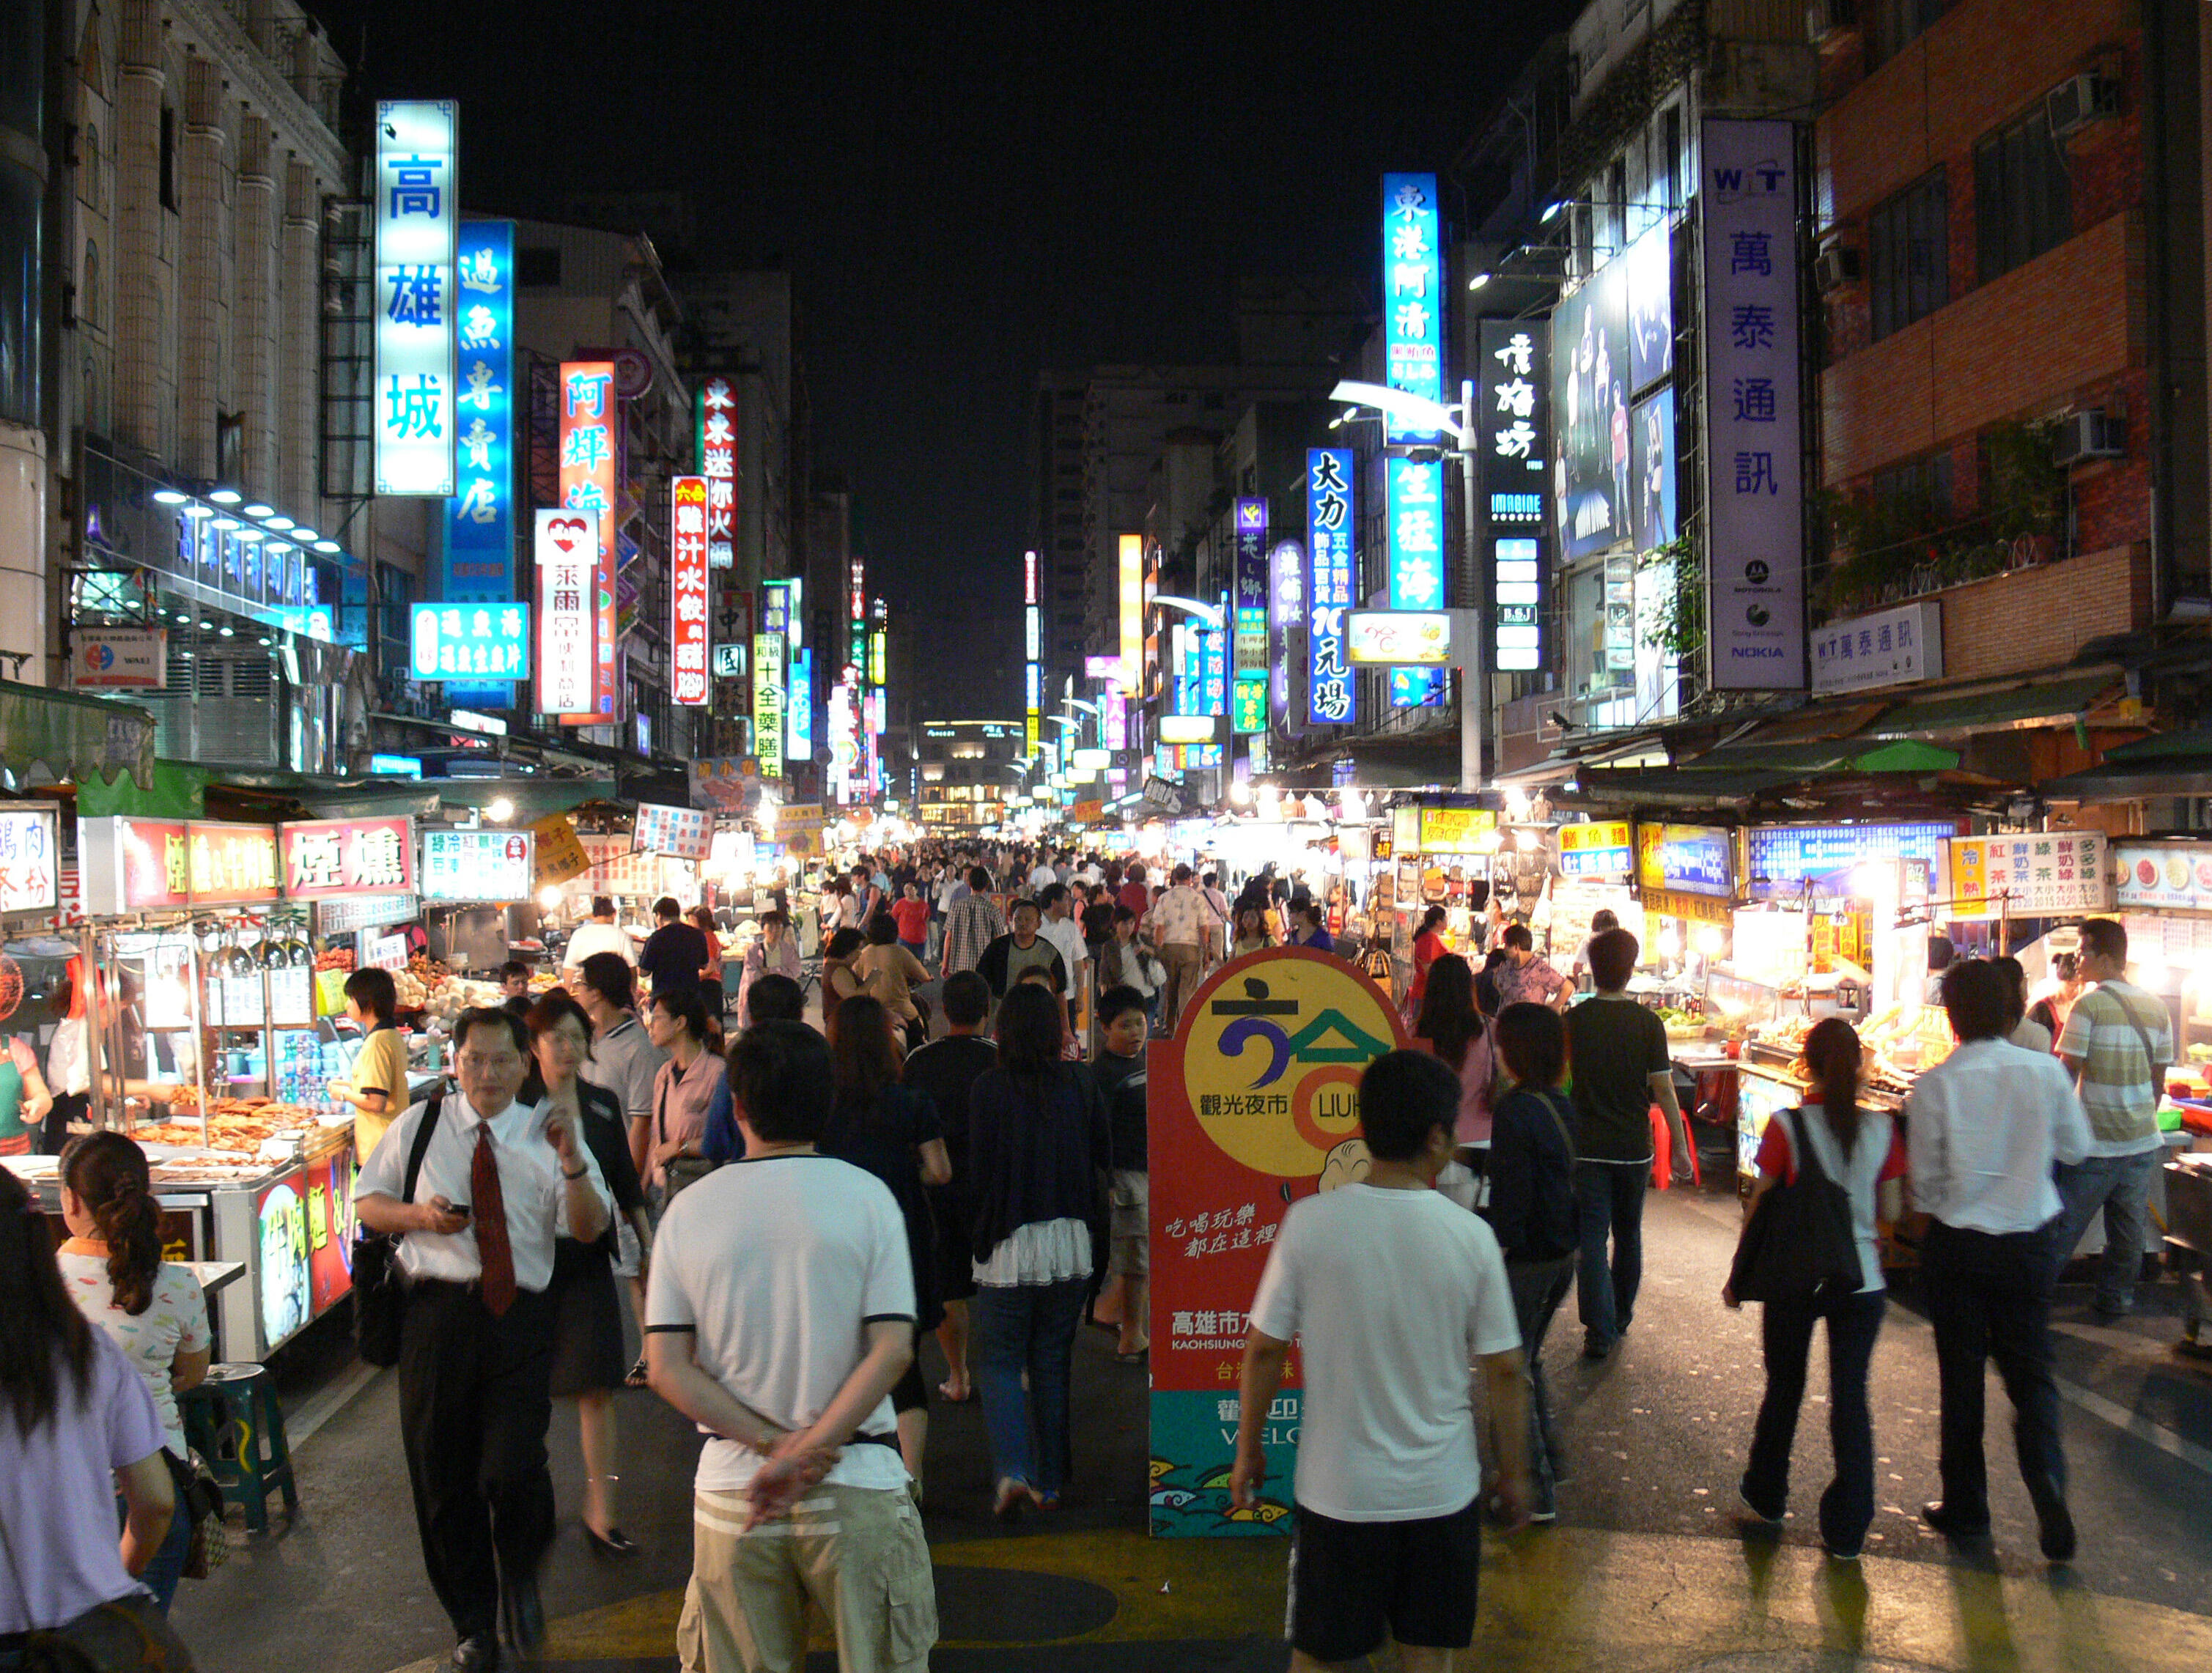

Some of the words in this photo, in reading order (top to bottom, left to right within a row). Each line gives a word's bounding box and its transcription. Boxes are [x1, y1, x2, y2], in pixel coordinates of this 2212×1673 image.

[386, 153, 443, 440] 高雄城
[1730, 231, 1778, 496] 萬泰通訊
[457, 248, 504, 524] 過魚專賣店
[1313, 451, 1348, 531] 大力
[1491, 494, 1541, 513] IMAGINE
[1314, 533, 1330, 603] 飾品百貨
[1332, 533, 1349, 603] 五金精品
[1731, 647, 1784, 658] NOKIA
[759, 662, 778, 777] 十全藥膳坊
[1989, 843, 2006, 884] 紅茶
[2013, 843, 2029, 882] 鮮奶茶
[2035, 841, 2051, 881] 綠茶
[2057, 841, 2074, 880] 鮮奶綠
[2079, 839, 2096, 879] 多多綠
[1200, 1093, 1289, 1116] 觀光夜市
[1165, 1202, 1256, 1238] 吃喝玩樂
[1184, 1222, 1278, 1260] 都在這裡
[1172, 1338, 1245, 1351] KAOHSIUNG
